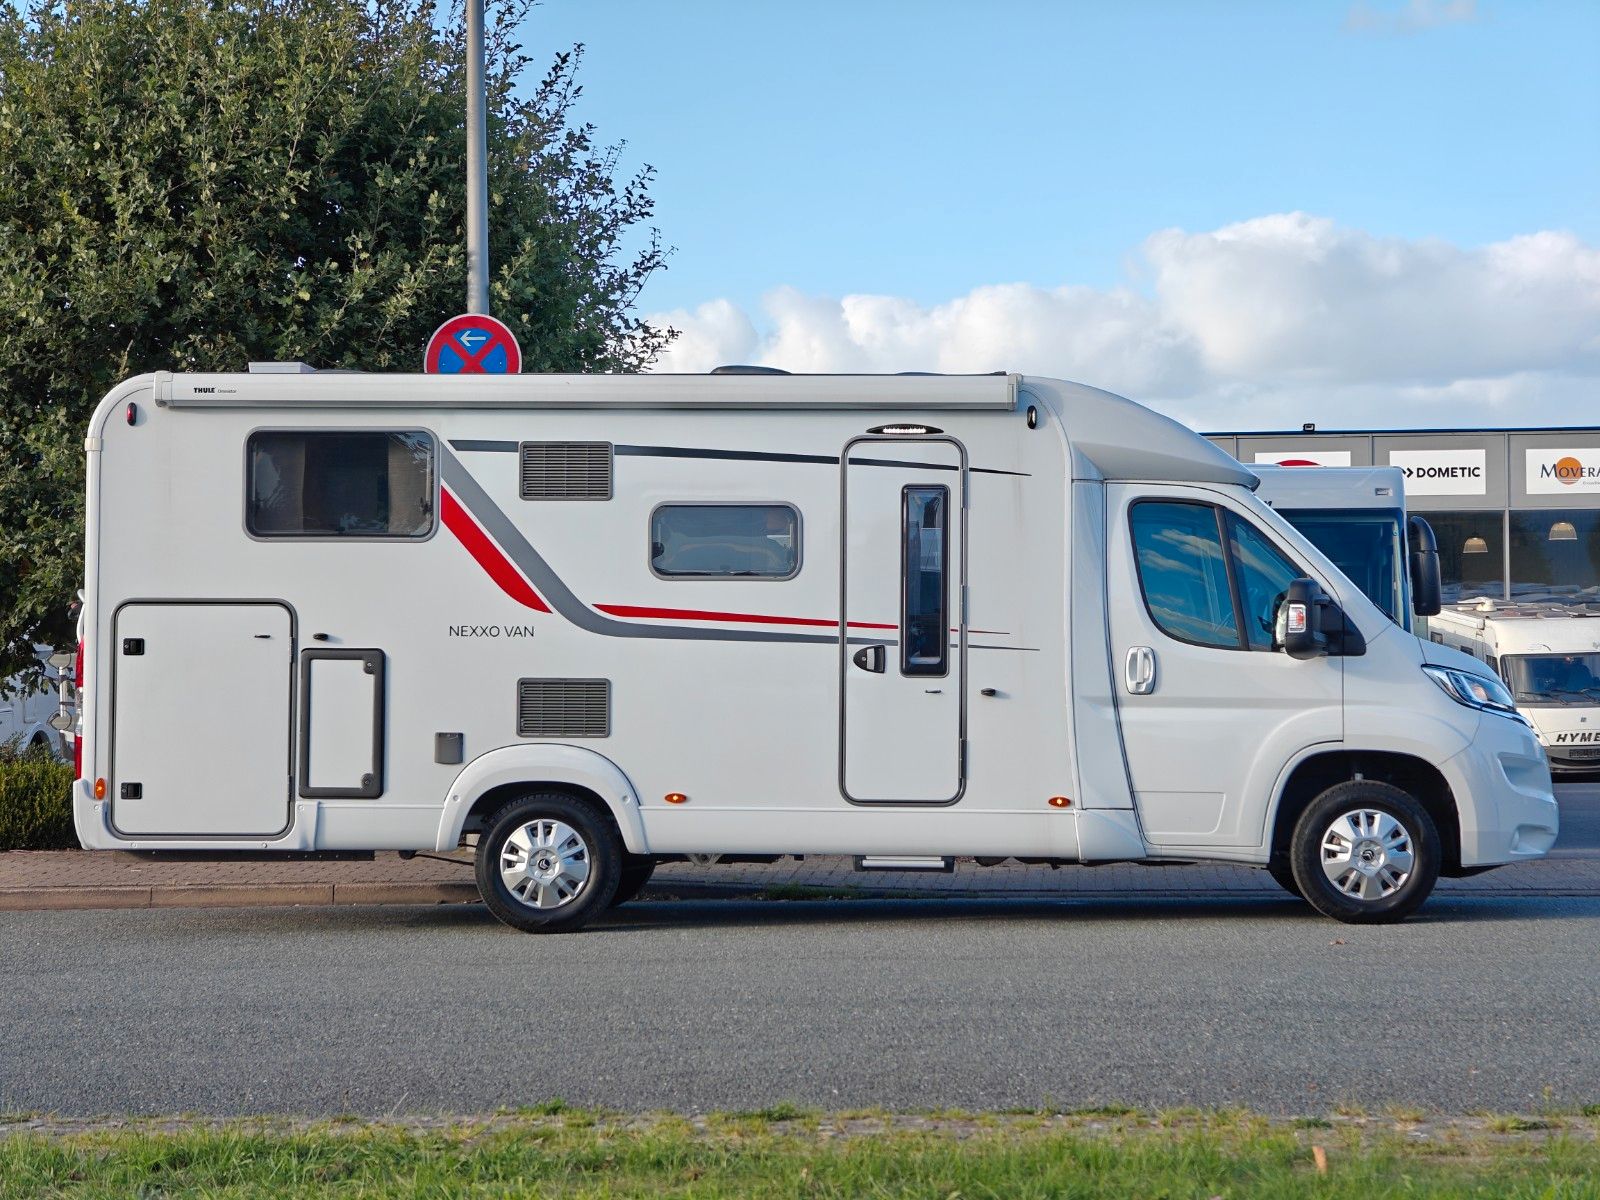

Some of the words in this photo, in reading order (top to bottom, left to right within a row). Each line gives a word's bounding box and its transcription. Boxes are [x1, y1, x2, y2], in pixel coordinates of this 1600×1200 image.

[1416, 466, 1481, 478] DOMETIC
[449, 625, 501, 638] NEXXO
[504, 625, 535, 638] VAN
[1556, 732, 1600, 743] HYME
